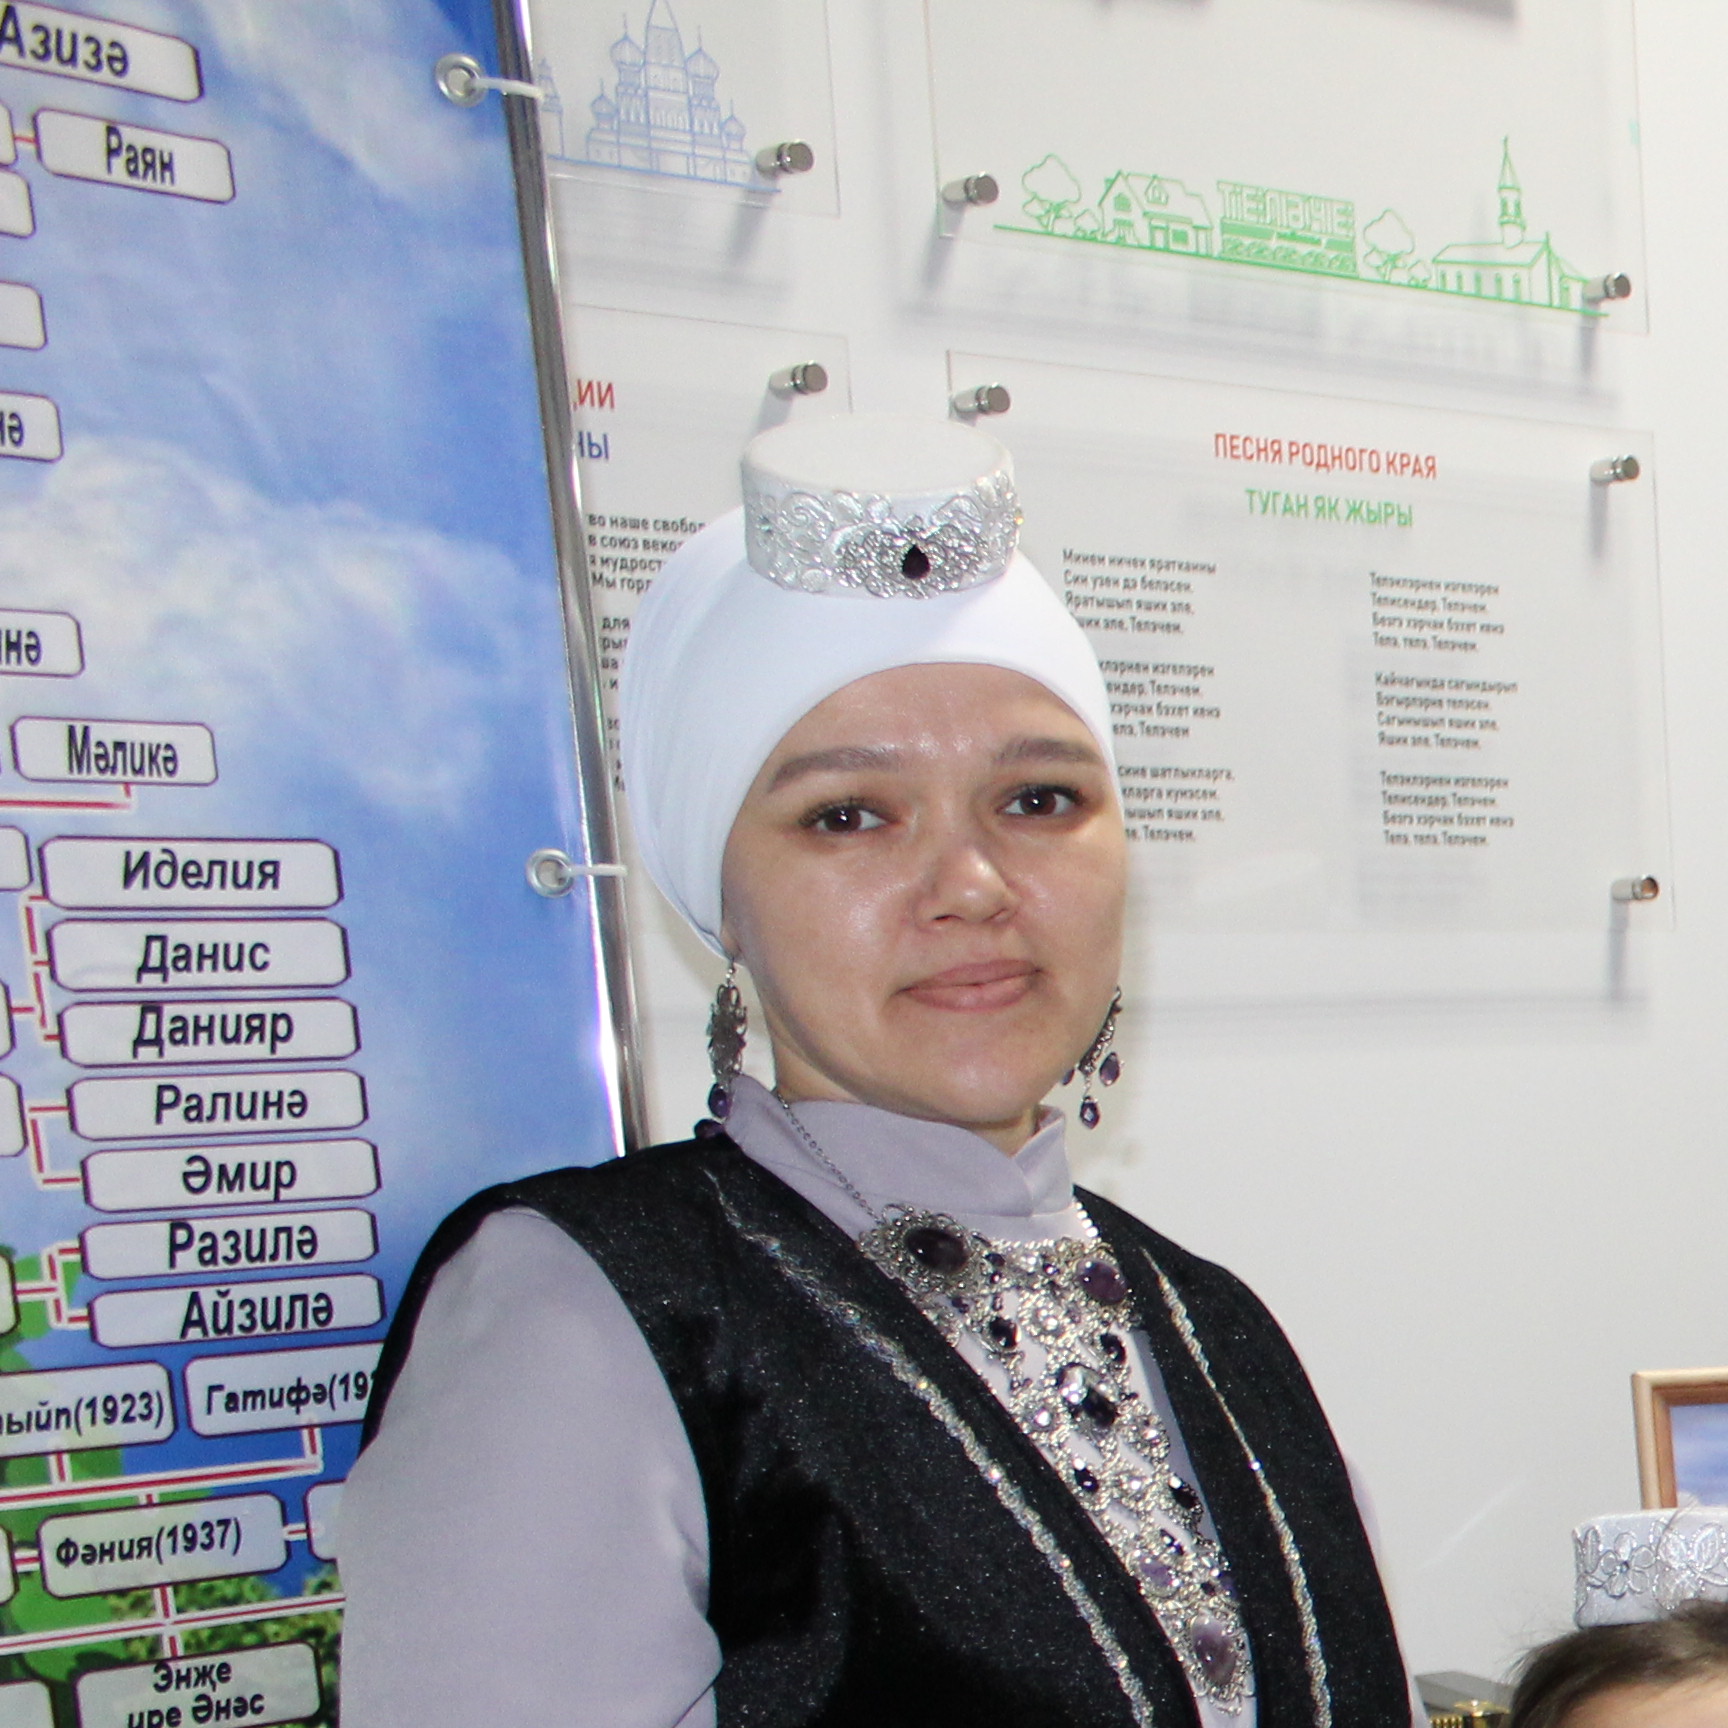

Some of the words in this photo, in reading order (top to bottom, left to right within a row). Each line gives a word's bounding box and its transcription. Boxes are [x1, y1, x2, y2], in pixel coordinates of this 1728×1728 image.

[105, 124, 175, 186] Раян
[1214, 433, 1283, 464] ПЕСНЯ
[1288, 441, 1381, 473] РОДНОГО
[1386, 451, 1438, 480] КРАЯ
[610, 516, 649, 530] наше
[1245, 488, 1309, 518] ТУГАН
[1314, 495, 1341, 522] ЯК
[1346, 498, 1414, 527] ЖЫРЫ
[600, 536, 639, 550] союз
[642, 538, 684, 552] веко
[600, 556, 665, 573] мудрост
[591, 571, 617, 589] Мы
[67, 724, 179, 778] Мәликә
[122, 848, 281, 891] Иделия
[136, 934, 271, 984] Данис
[132, 1004, 294, 1059] Данияр
[155, 1084, 309, 1126] Ралинә
[182, 1155, 298, 1202] Әмир
[168, 1220, 319, 1270] Разилә
[180, 1289, 334, 1342] Айзилә
[0, 1390, 164, 1437] ыйп(1923)
[206, 1370, 377, 1416] Гатифә(19
[56, 1517, 242, 1568] Фәния(1937)
[191, 1693, 265, 1726] Әнәс
